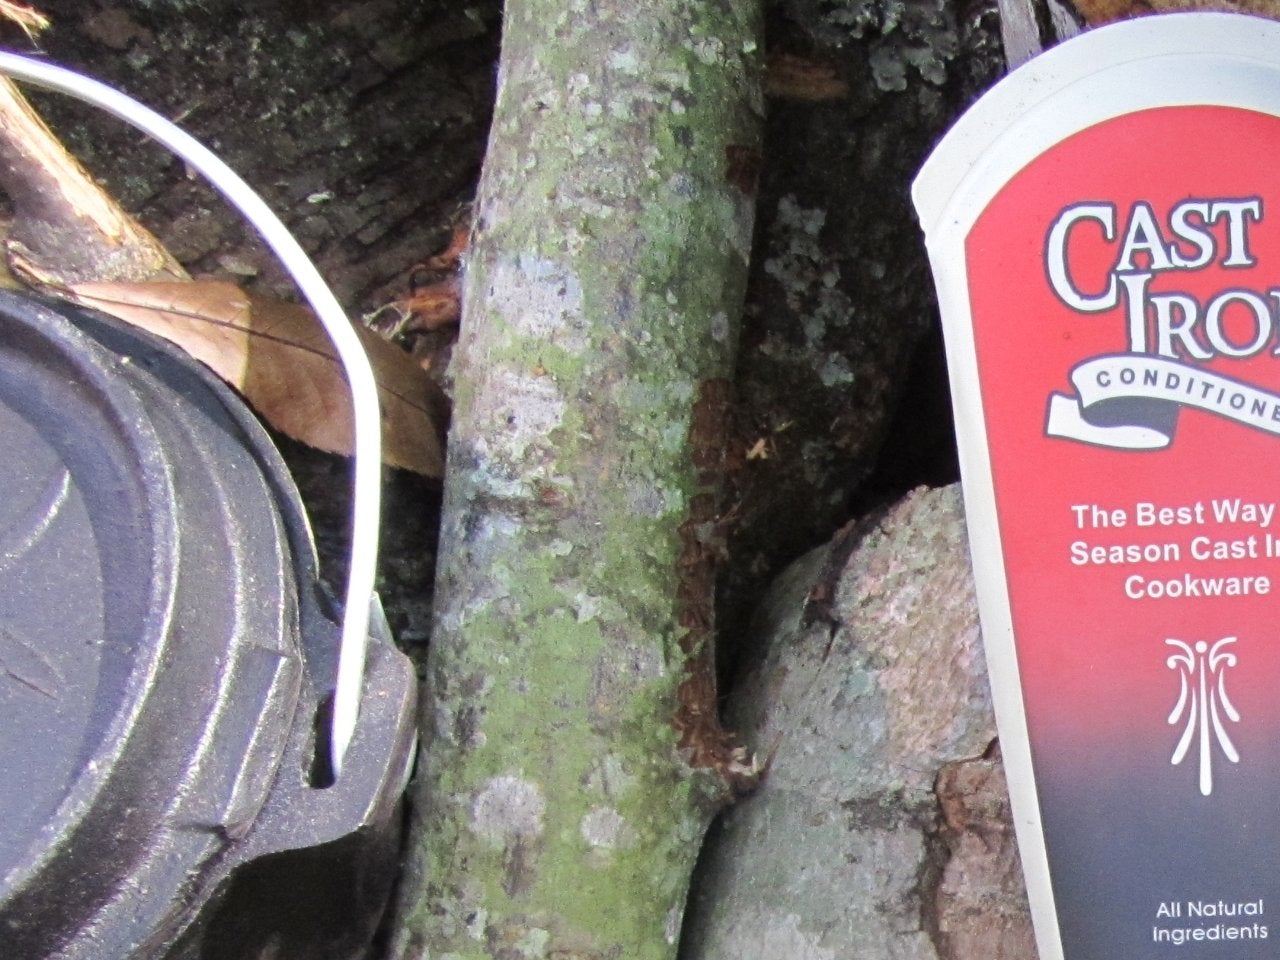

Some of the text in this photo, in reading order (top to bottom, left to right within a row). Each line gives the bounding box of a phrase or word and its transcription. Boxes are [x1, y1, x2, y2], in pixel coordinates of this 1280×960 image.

[1045, 198, 1262, 312] CAST
[1072, 504, 1127, 529] The
[1136, 502, 1205, 526] Best
[1212, 498, 1275, 527] Way
[1070, 537, 1180, 565] Season
[1190, 535, 1258, 560] Cast
[1124, 573, 1271, 599] Cookware
[1156, 900, 1263, 918] All Natural
[1153, 923, 1268, 945] Ingredients
